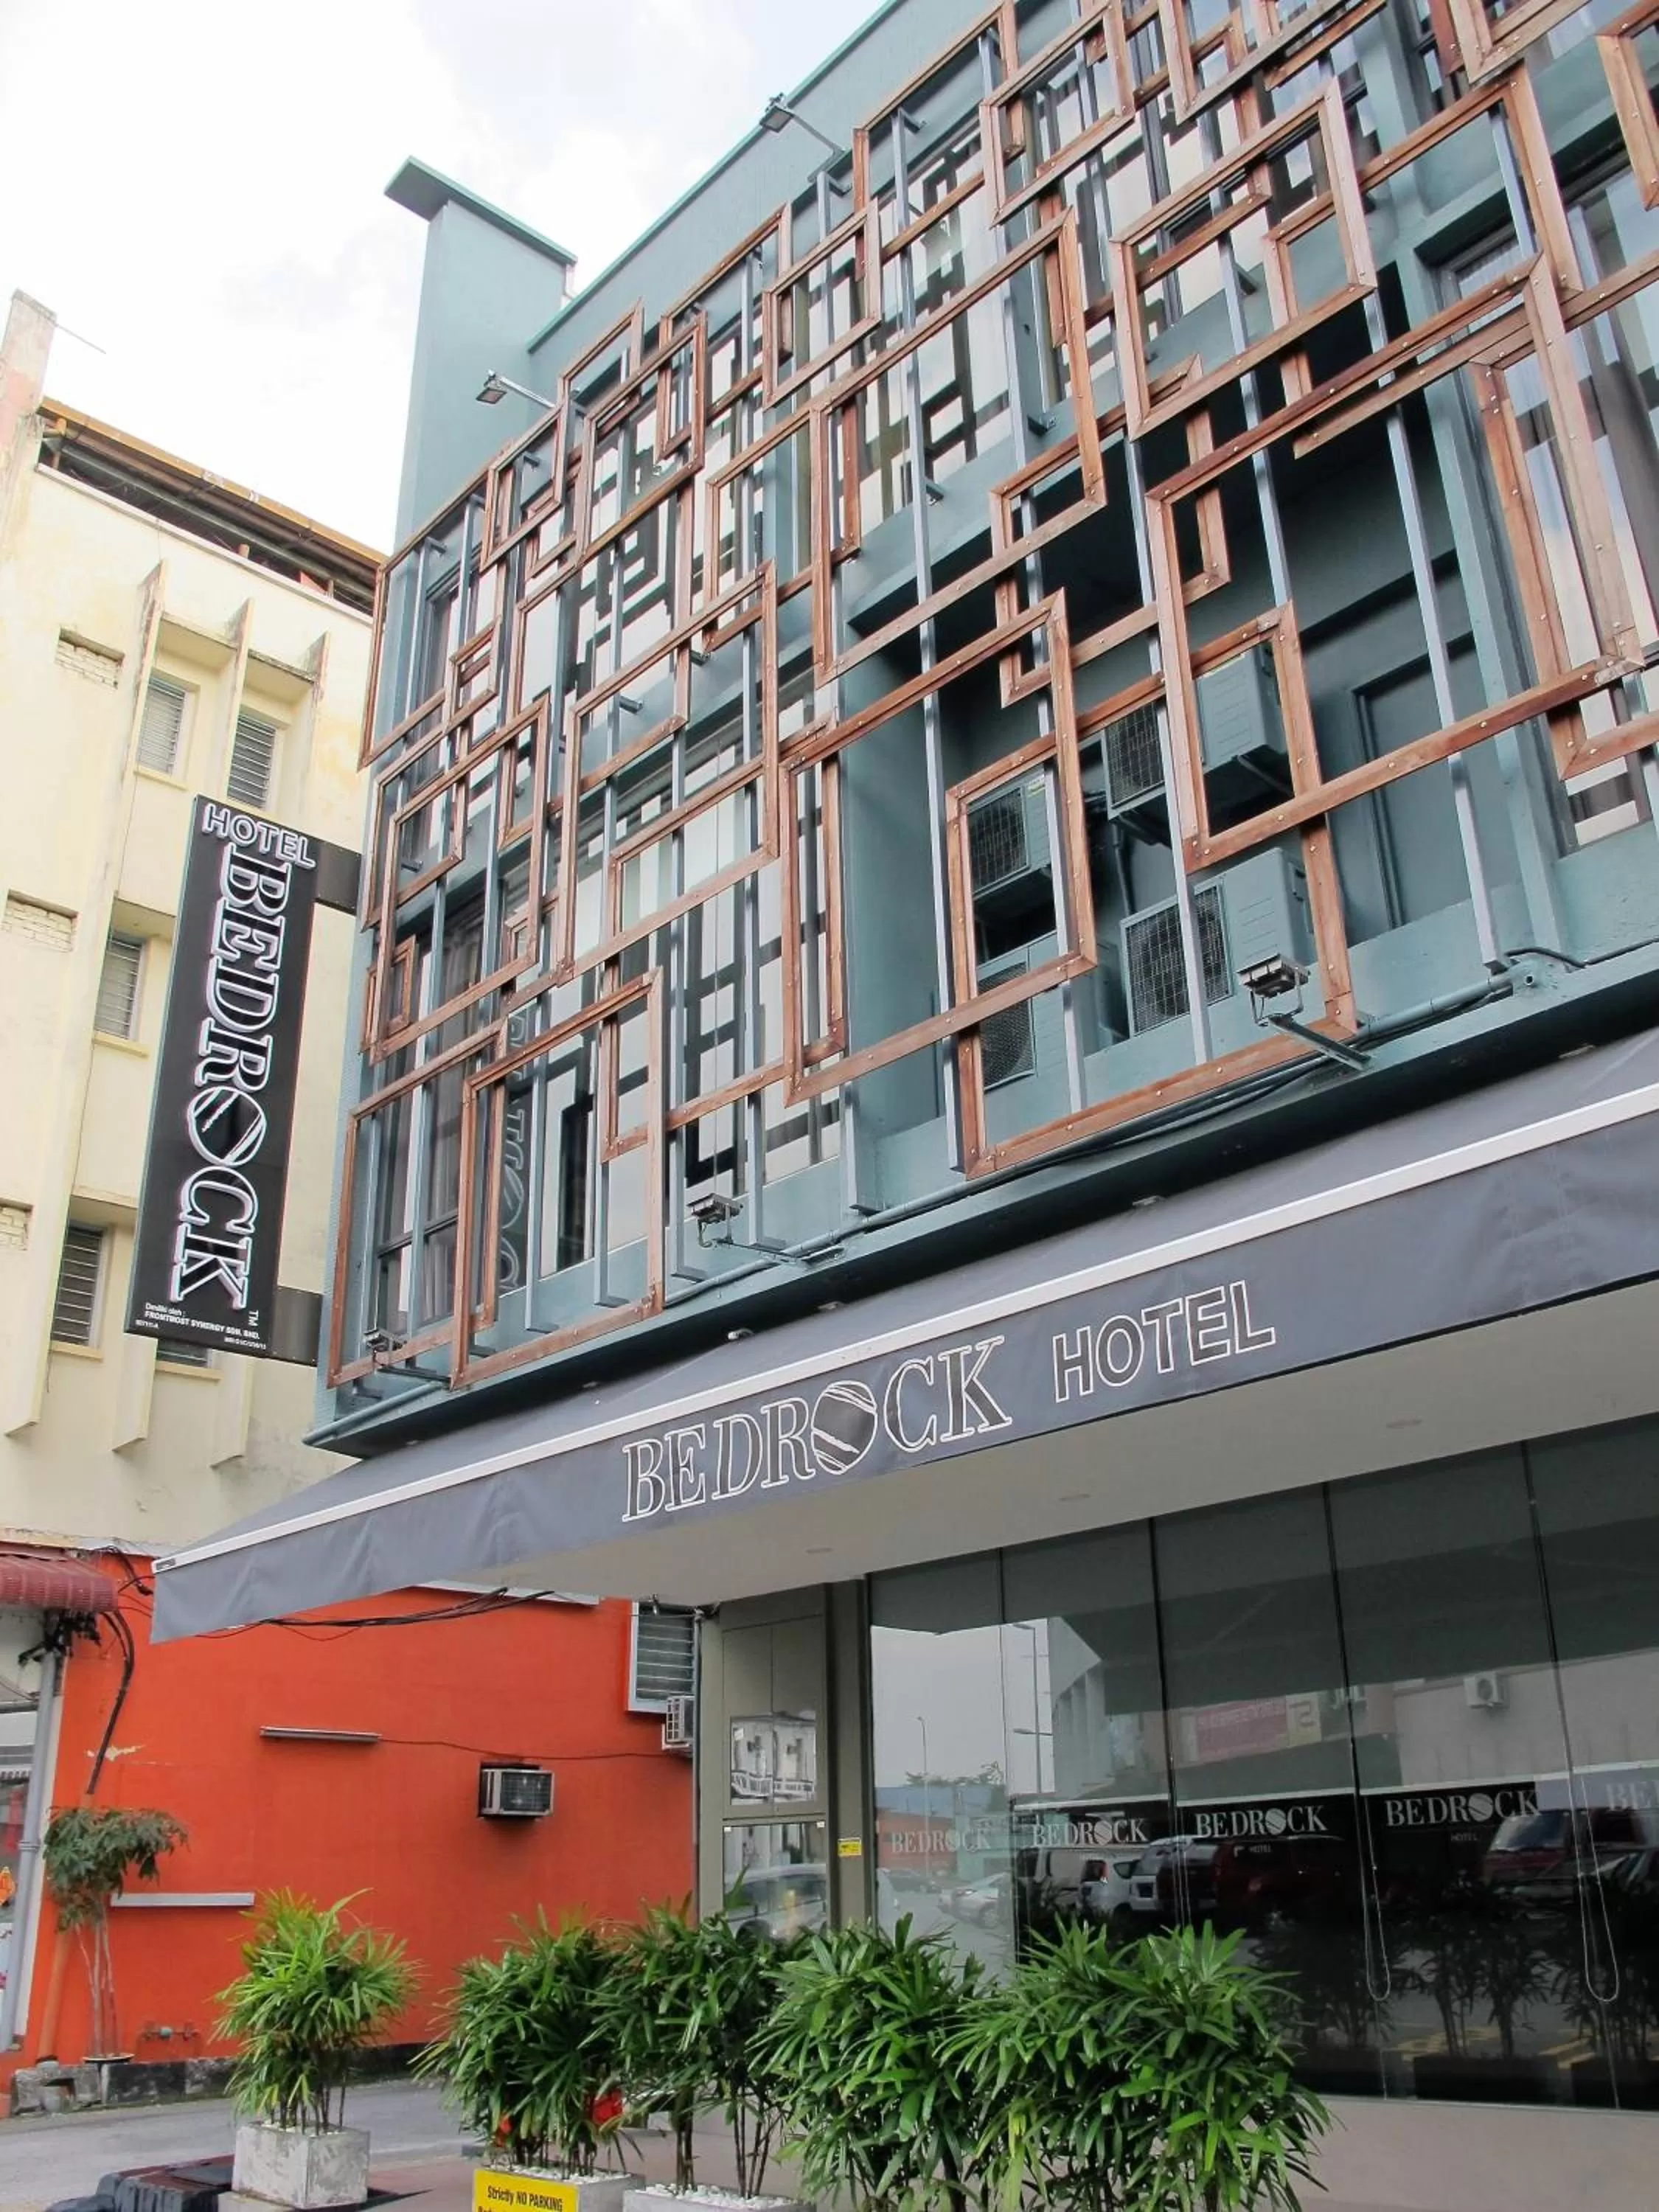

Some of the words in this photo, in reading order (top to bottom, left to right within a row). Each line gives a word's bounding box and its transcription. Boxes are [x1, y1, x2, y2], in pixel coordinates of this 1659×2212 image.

[202, 803, 316, 869] HOTEL
[170, 842, 292, 1310] BEDROCK
[621, 1335, 1013, 1523] BEDROCK
[1051, 1279, 1277, 1403] HOTEL
[1194, 1805, 1328, 1838] BEDROCK
[1385, 1790, 1543, 1826] BEDROCK
[1032, 1818, 1150, 1847] BEDROCK
[487, 2185, 515, 2205] Strictly
[516, 2191, 527, 2205] NO
[529, 2194, 563, 2212] PARKING
